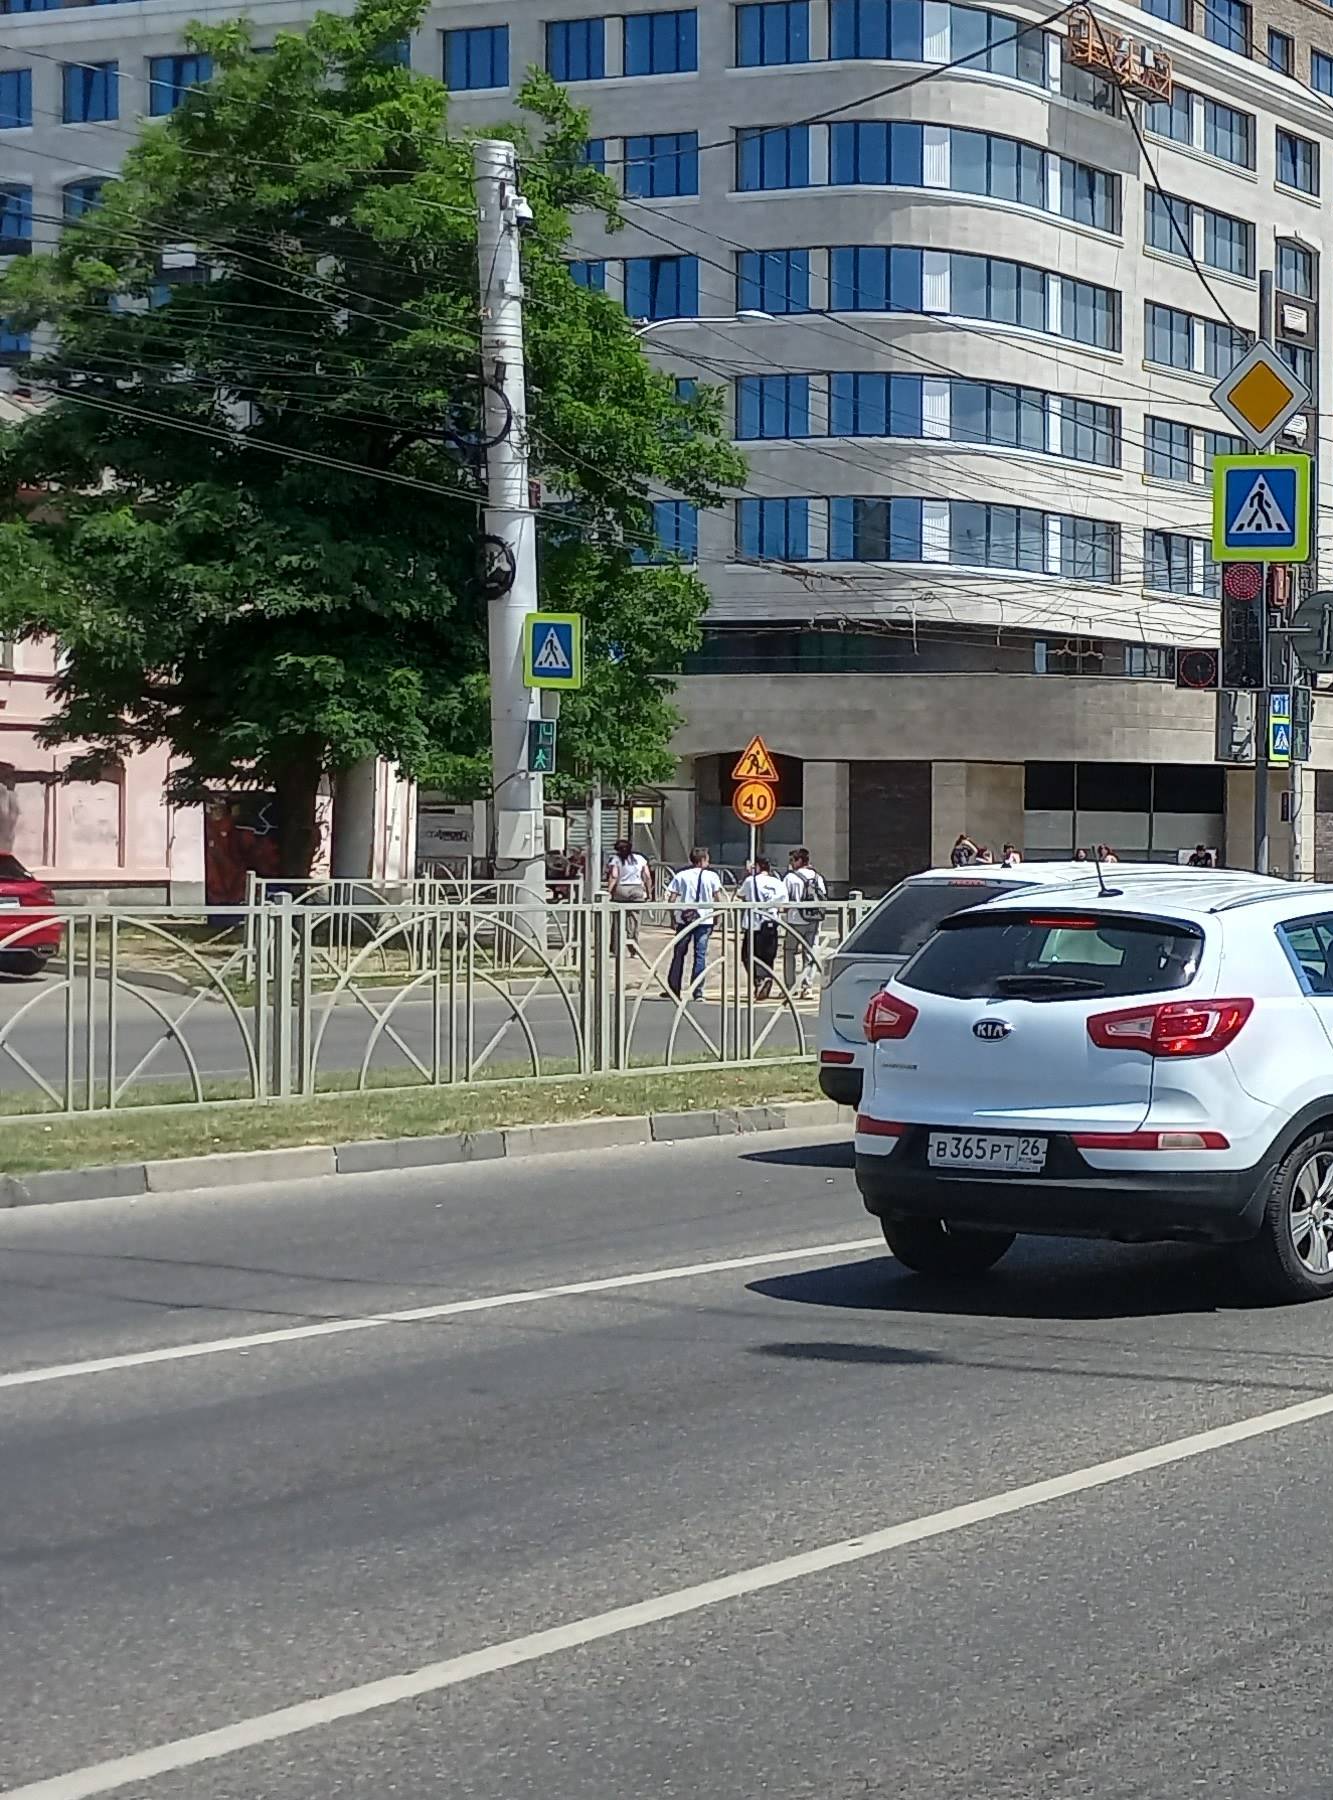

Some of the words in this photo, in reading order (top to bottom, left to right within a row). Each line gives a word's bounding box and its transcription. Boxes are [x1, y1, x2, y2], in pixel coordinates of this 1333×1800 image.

[742, 793, 767, 811] 40
[976, 1023, 1003, 1037] KIA
[936, 1137, 1015, 1161] В365РТ
[1020, 1139, 1040, 1156] 26
